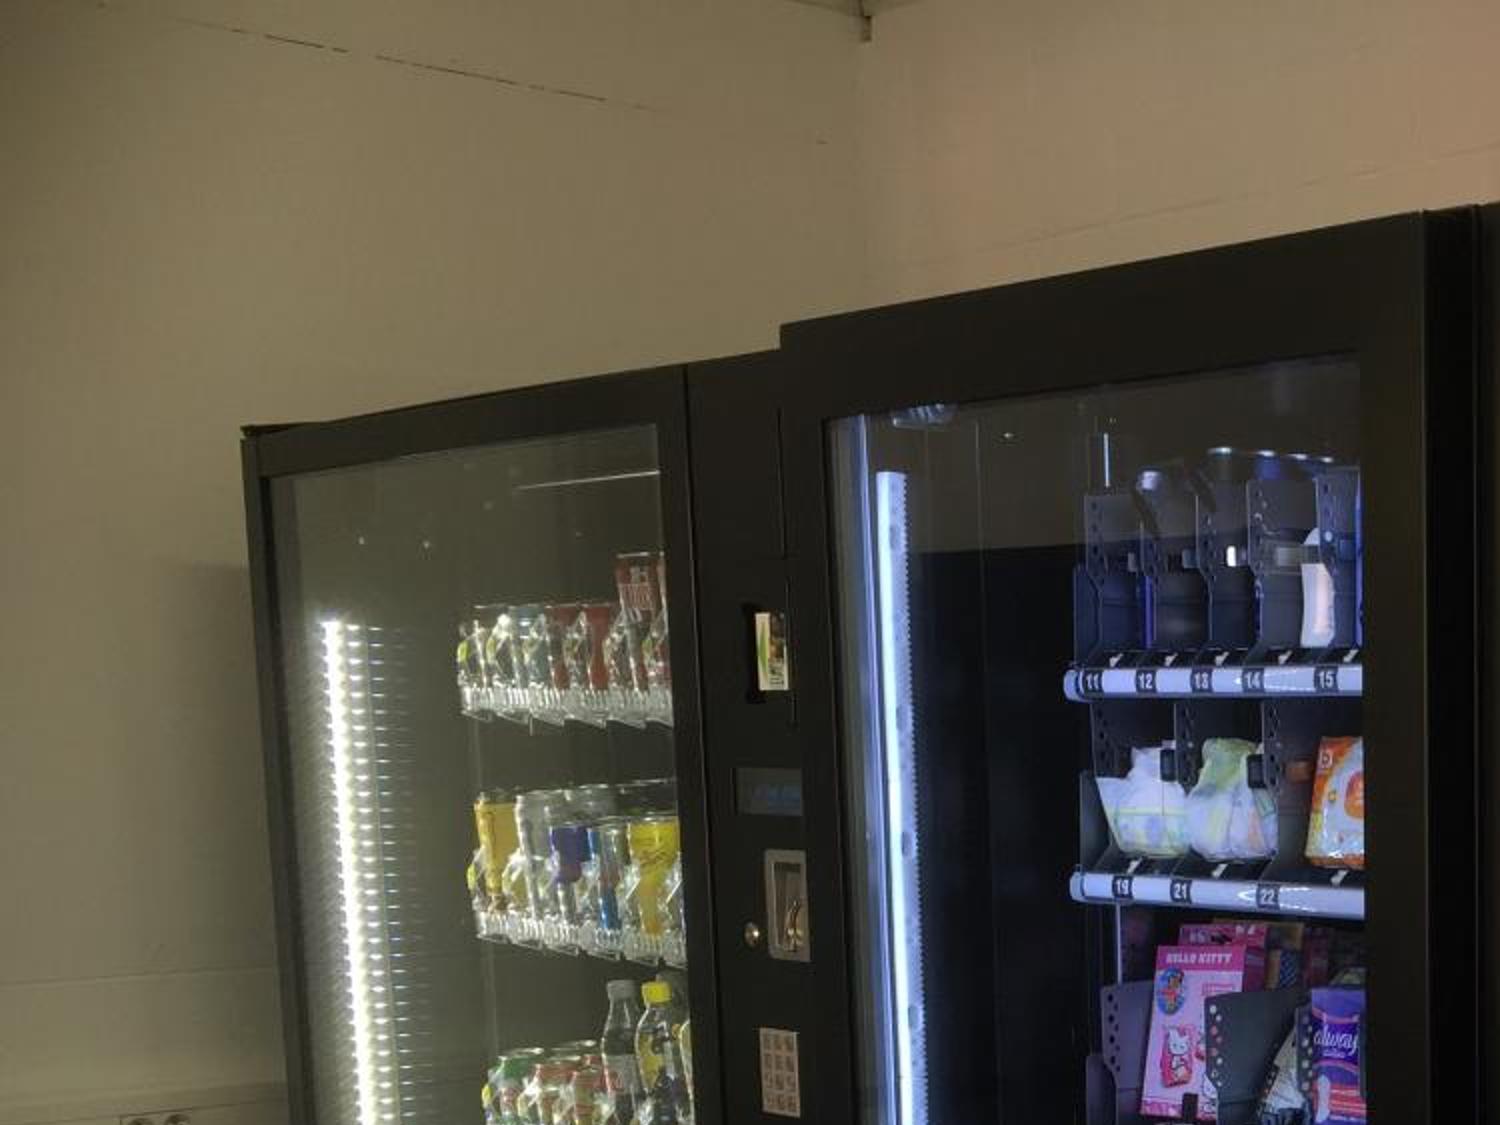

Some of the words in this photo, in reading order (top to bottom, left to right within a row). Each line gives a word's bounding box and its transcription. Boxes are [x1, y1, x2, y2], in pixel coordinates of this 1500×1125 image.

[1137, 673, 1153, 689] 12
[1243, 671, 1260, 689] 14
[1317, 670, 1334, 688] 15
[1114, 878, 1129, 896] 19
[1173, 883, 1189, 901] 21
[1259, 888, 1276, 906] 22
[1197, 953, 1233, 965] KITTY
